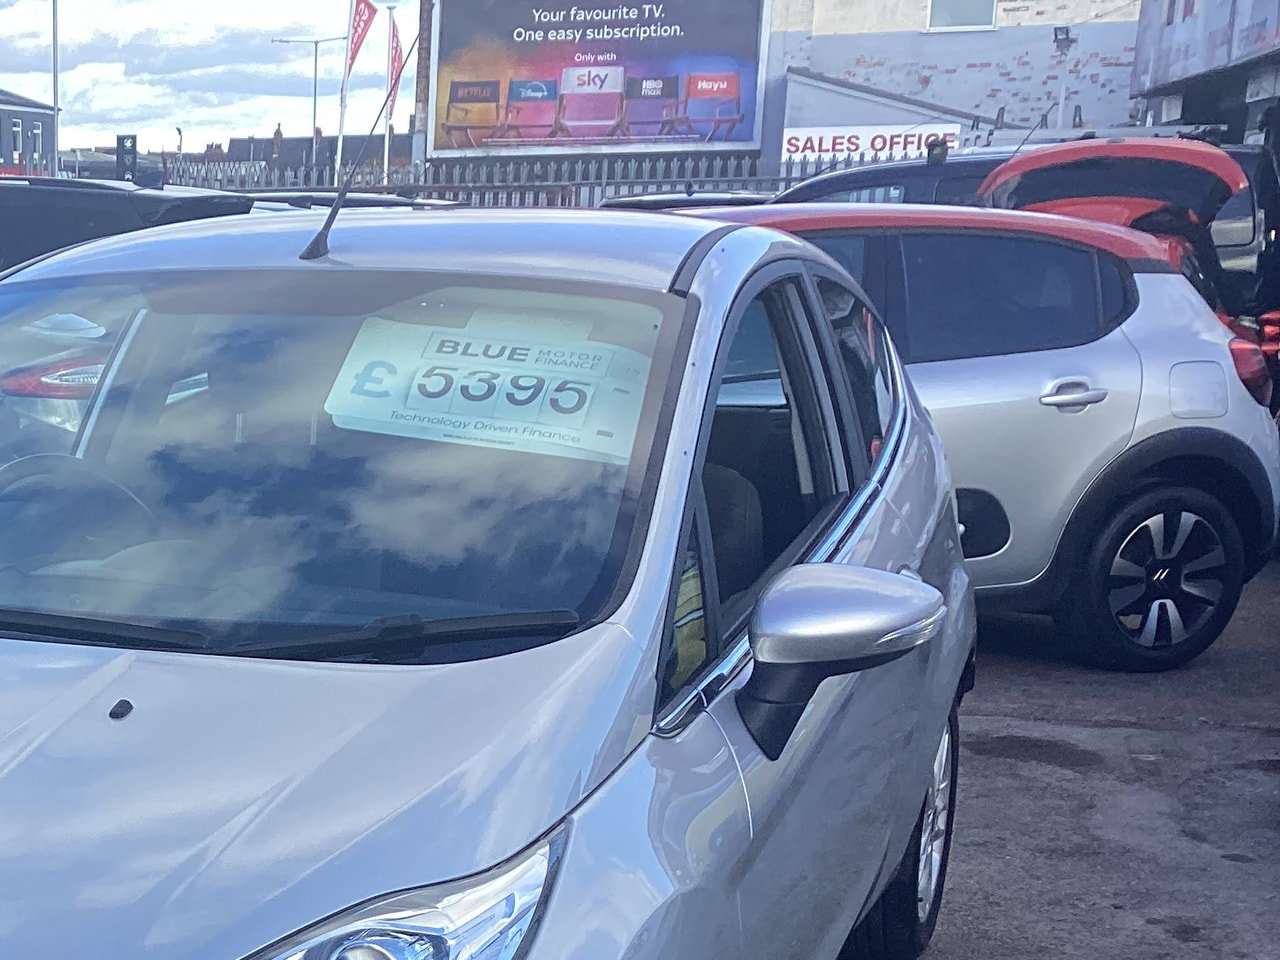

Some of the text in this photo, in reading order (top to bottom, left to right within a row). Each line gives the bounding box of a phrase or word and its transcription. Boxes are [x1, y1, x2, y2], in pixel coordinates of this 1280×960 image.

[532, 4, 665, 23] Your favourite TV.
[513, 23, 685, 43] One easy subscription.
[574, 52, 617, 64] Only with
[576, 69, 609, 90] sky
[786, 135, 861, 154] SALES
[435, 339, 602, 362] BLUE MOTOR
[535, 357, 600, 370] FINANCE
[417, 366, 591, 414] 5395
[390, 410, 470, 431] Technology
[474, 420, 519, 435] Driven
[521, 425, 581, 443] Finance
